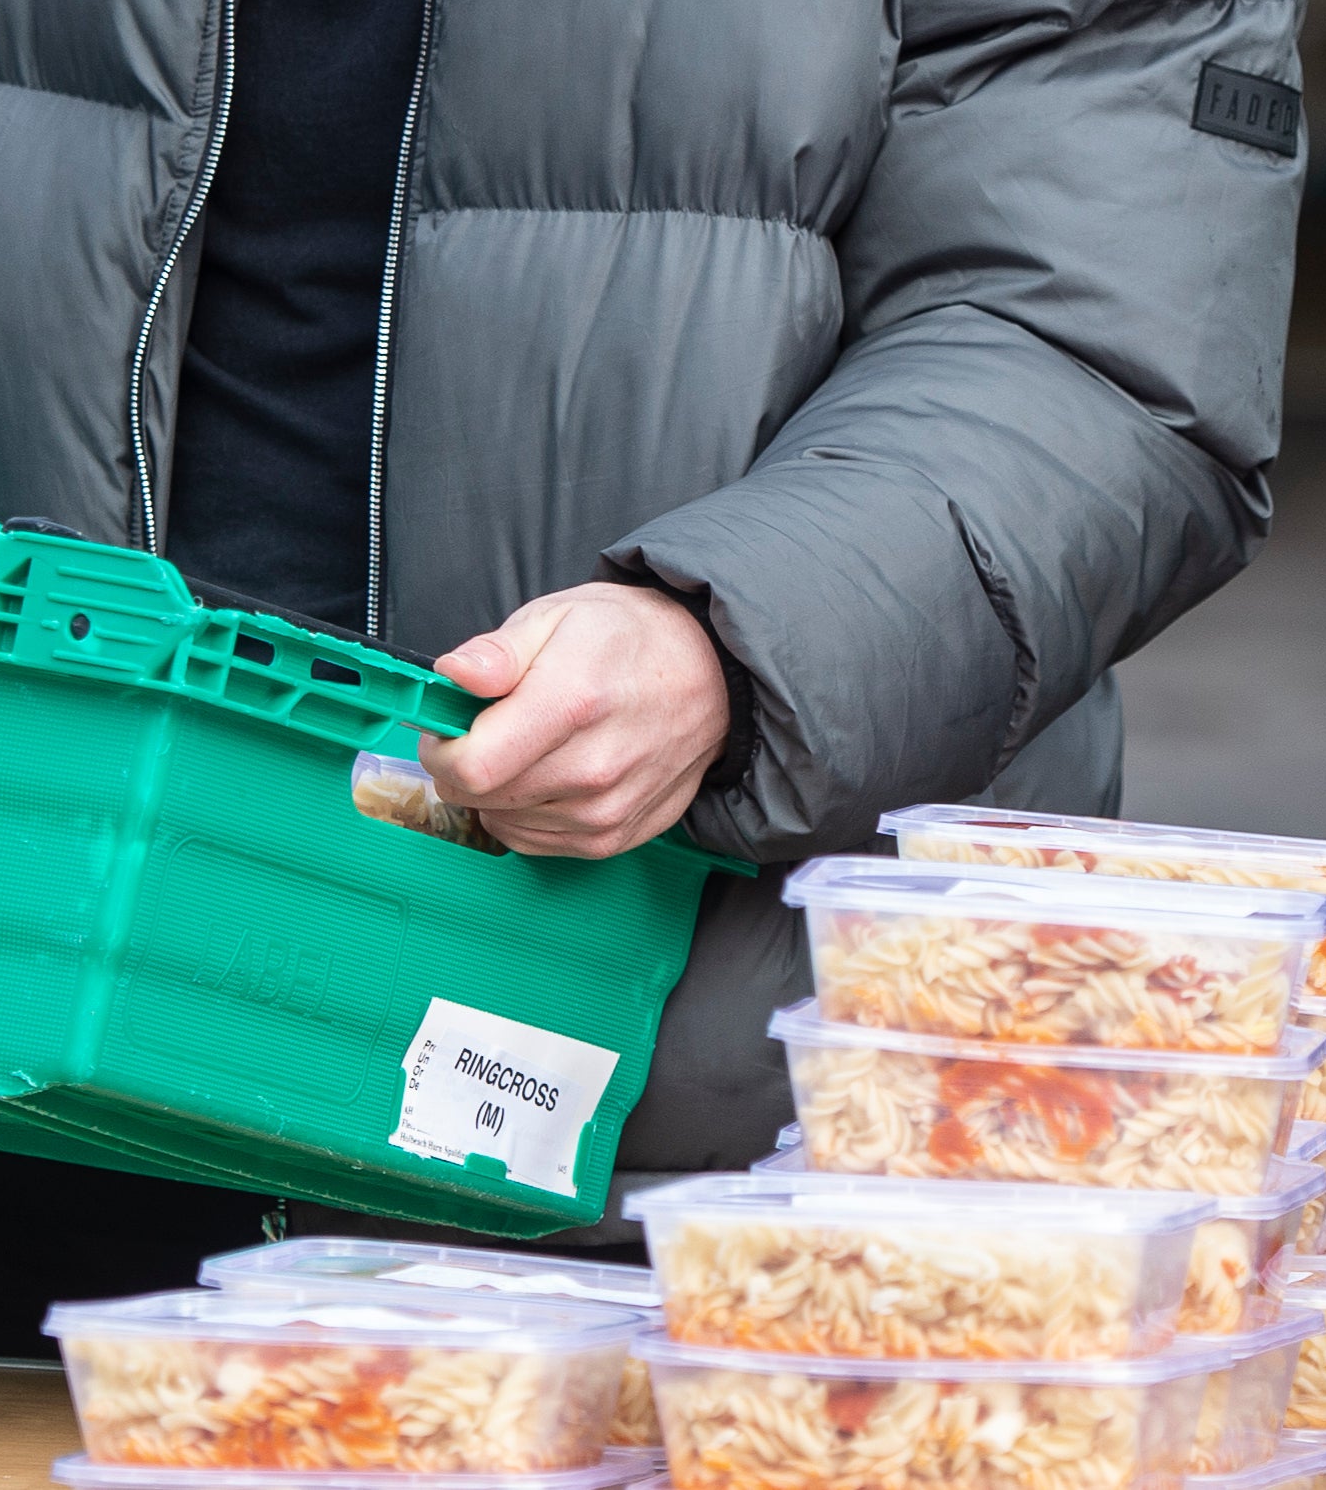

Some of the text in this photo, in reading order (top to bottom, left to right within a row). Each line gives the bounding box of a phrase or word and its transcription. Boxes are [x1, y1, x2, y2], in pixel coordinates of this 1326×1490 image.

[1208, 82, 1294, 137] FADED
[454, 1047, 560, 1112] RINGCROSS
[475, 1100, 505, 1137] (M)
